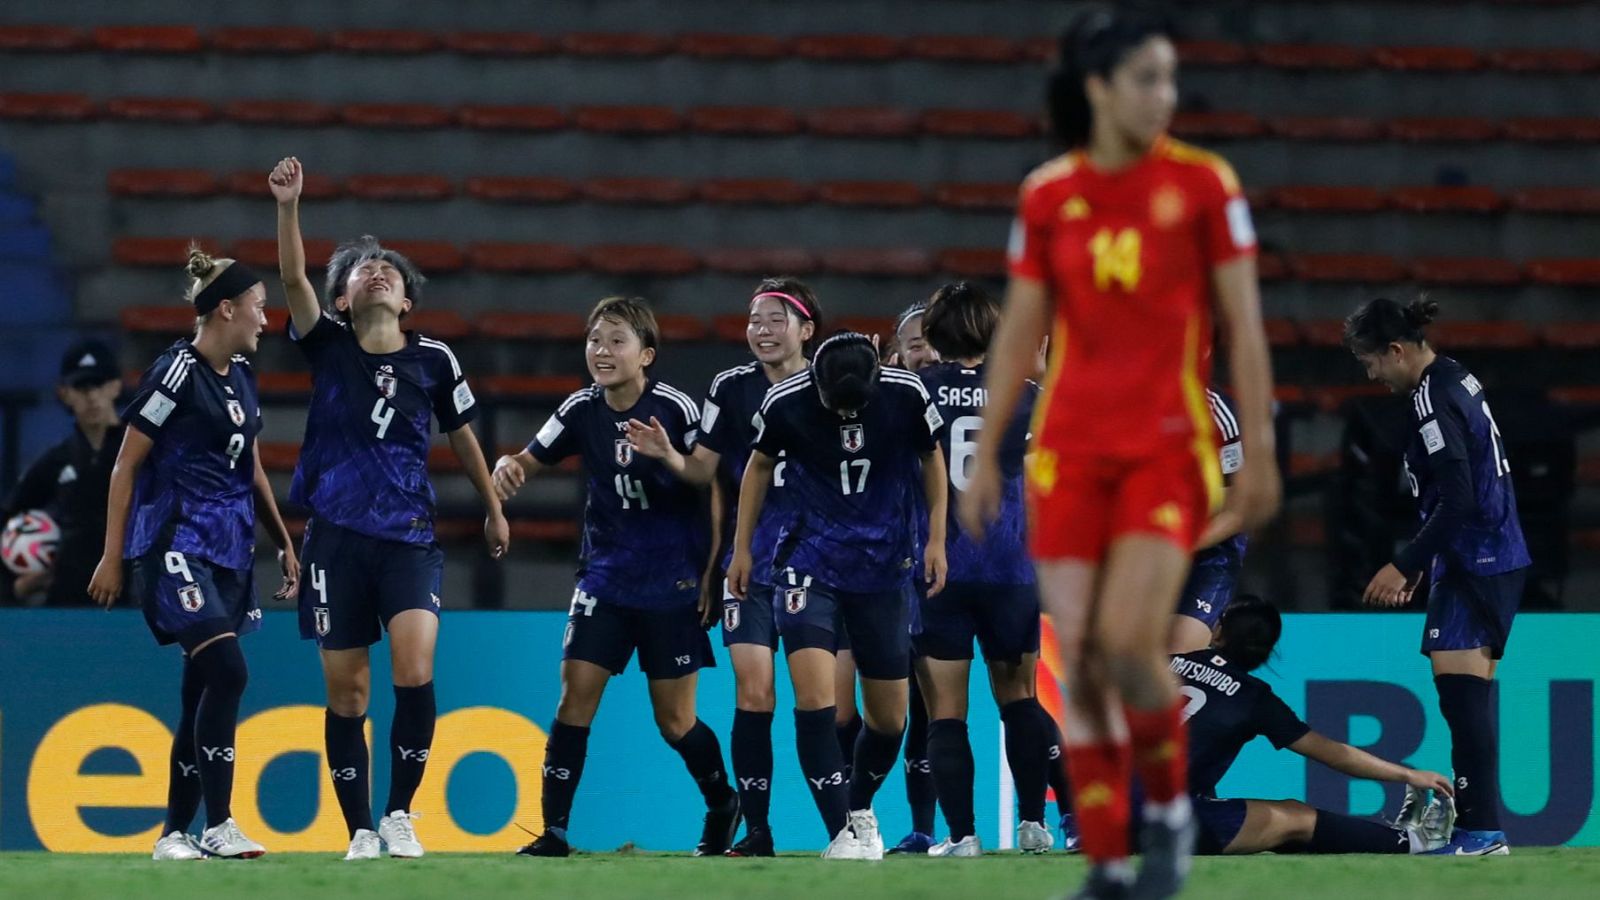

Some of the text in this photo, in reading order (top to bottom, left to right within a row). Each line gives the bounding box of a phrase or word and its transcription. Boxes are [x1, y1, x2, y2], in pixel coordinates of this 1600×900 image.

[1087, 226, 1141, 293] 14
[938, 385, 988, 407] SASA
[371, 397, 396, 439] 4
[225, 432, 246, 469] 9
[949, 416, 986, 493] 6
[614, 473, 649, 510] 14
[840, 458, 871, 495] 17
[164, 551, 194, 582] 9
[311, 562, 328, 604] 4
[1196, 599, 1212, 614] Y-3
[1169, 656, 1241, 696] MATSUKUBO
[202, 746, 235, 762] Y-3
[398, 745, 429, 762] Y-3
[541, 764, 571, 780] Y-3
[739, 777, 768, 791] Y-3
[809, 771, 843, 790] Y-3
